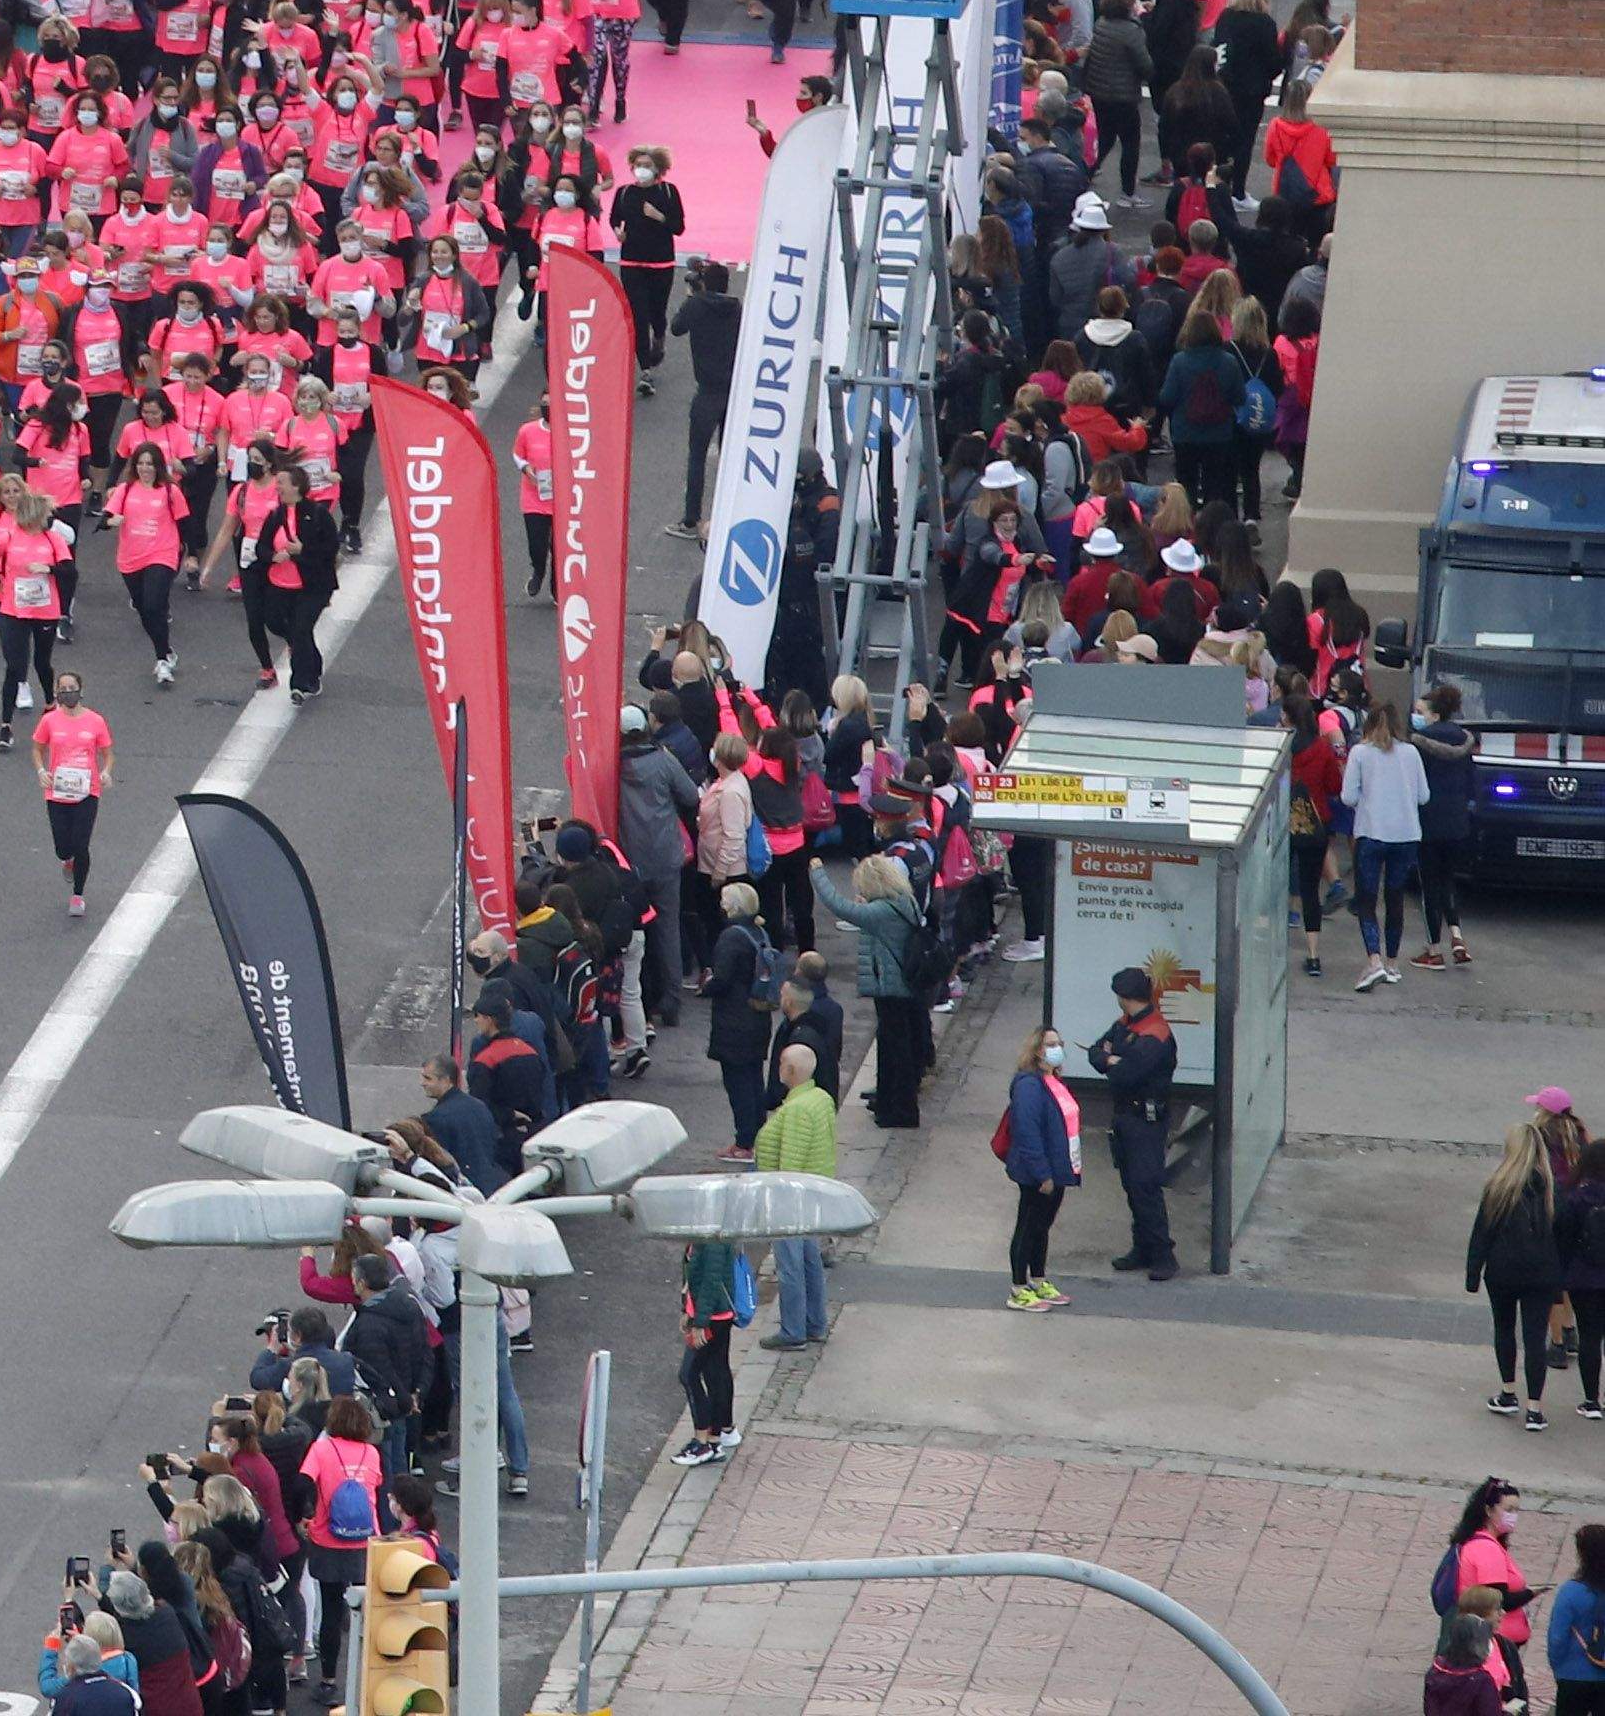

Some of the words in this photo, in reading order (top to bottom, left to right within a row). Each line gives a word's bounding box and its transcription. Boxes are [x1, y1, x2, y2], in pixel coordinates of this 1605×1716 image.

[744, 242, 809, 491] ZURICH
[977, 777, 991, 787] 13
[997, 790, 1016, 801] E70
[1063, 792, 1082, 802] L70
[1081, 857, 1102, 872] de
[1105, 860, 1146, 875] casa?
[1112, 885, 1141, 898] gratis
[1146, 888, 1154, 896] a
[1077, 895, 1117, 909] puntos
[1119, 898, 1135, 908] de
[1136, 899, 1185, 913] recogida
[1077, 909, 1107, 921] cerca
[1109, 909, 1125, 921] de
[1126, 911, 1136, 922] ti
